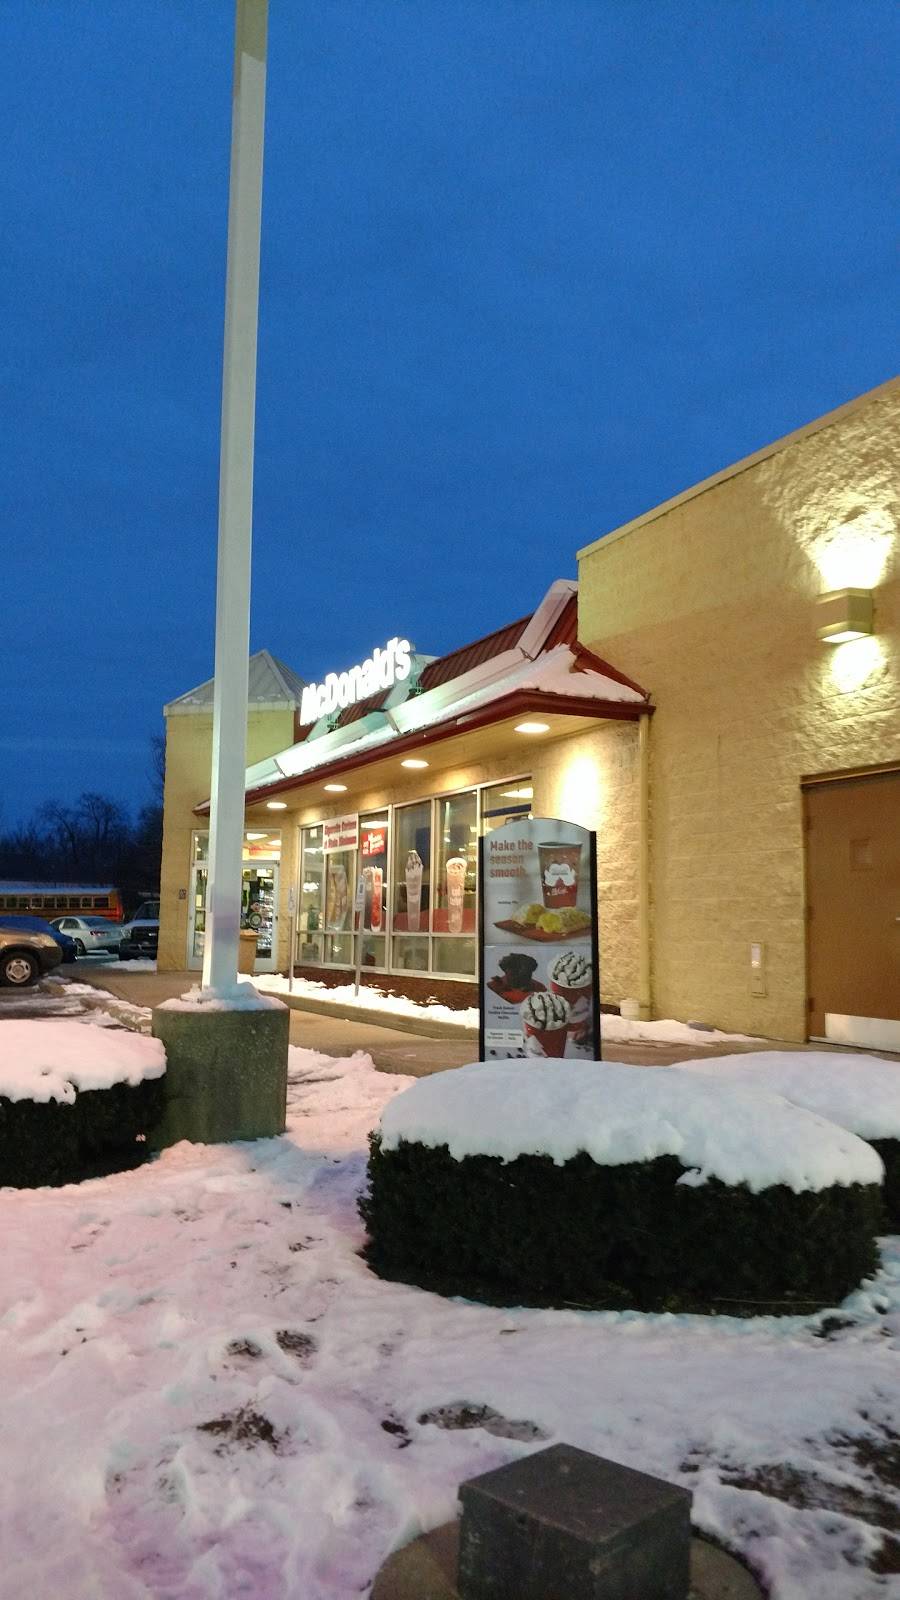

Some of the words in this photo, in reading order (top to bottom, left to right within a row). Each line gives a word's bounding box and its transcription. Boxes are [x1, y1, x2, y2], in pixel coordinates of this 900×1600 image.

[300, 637, 411, 726] McDonald's
[490, 839, 515, 852] Make
[517, 839, 534, 851] the
[489, 854, 525, 865] season
